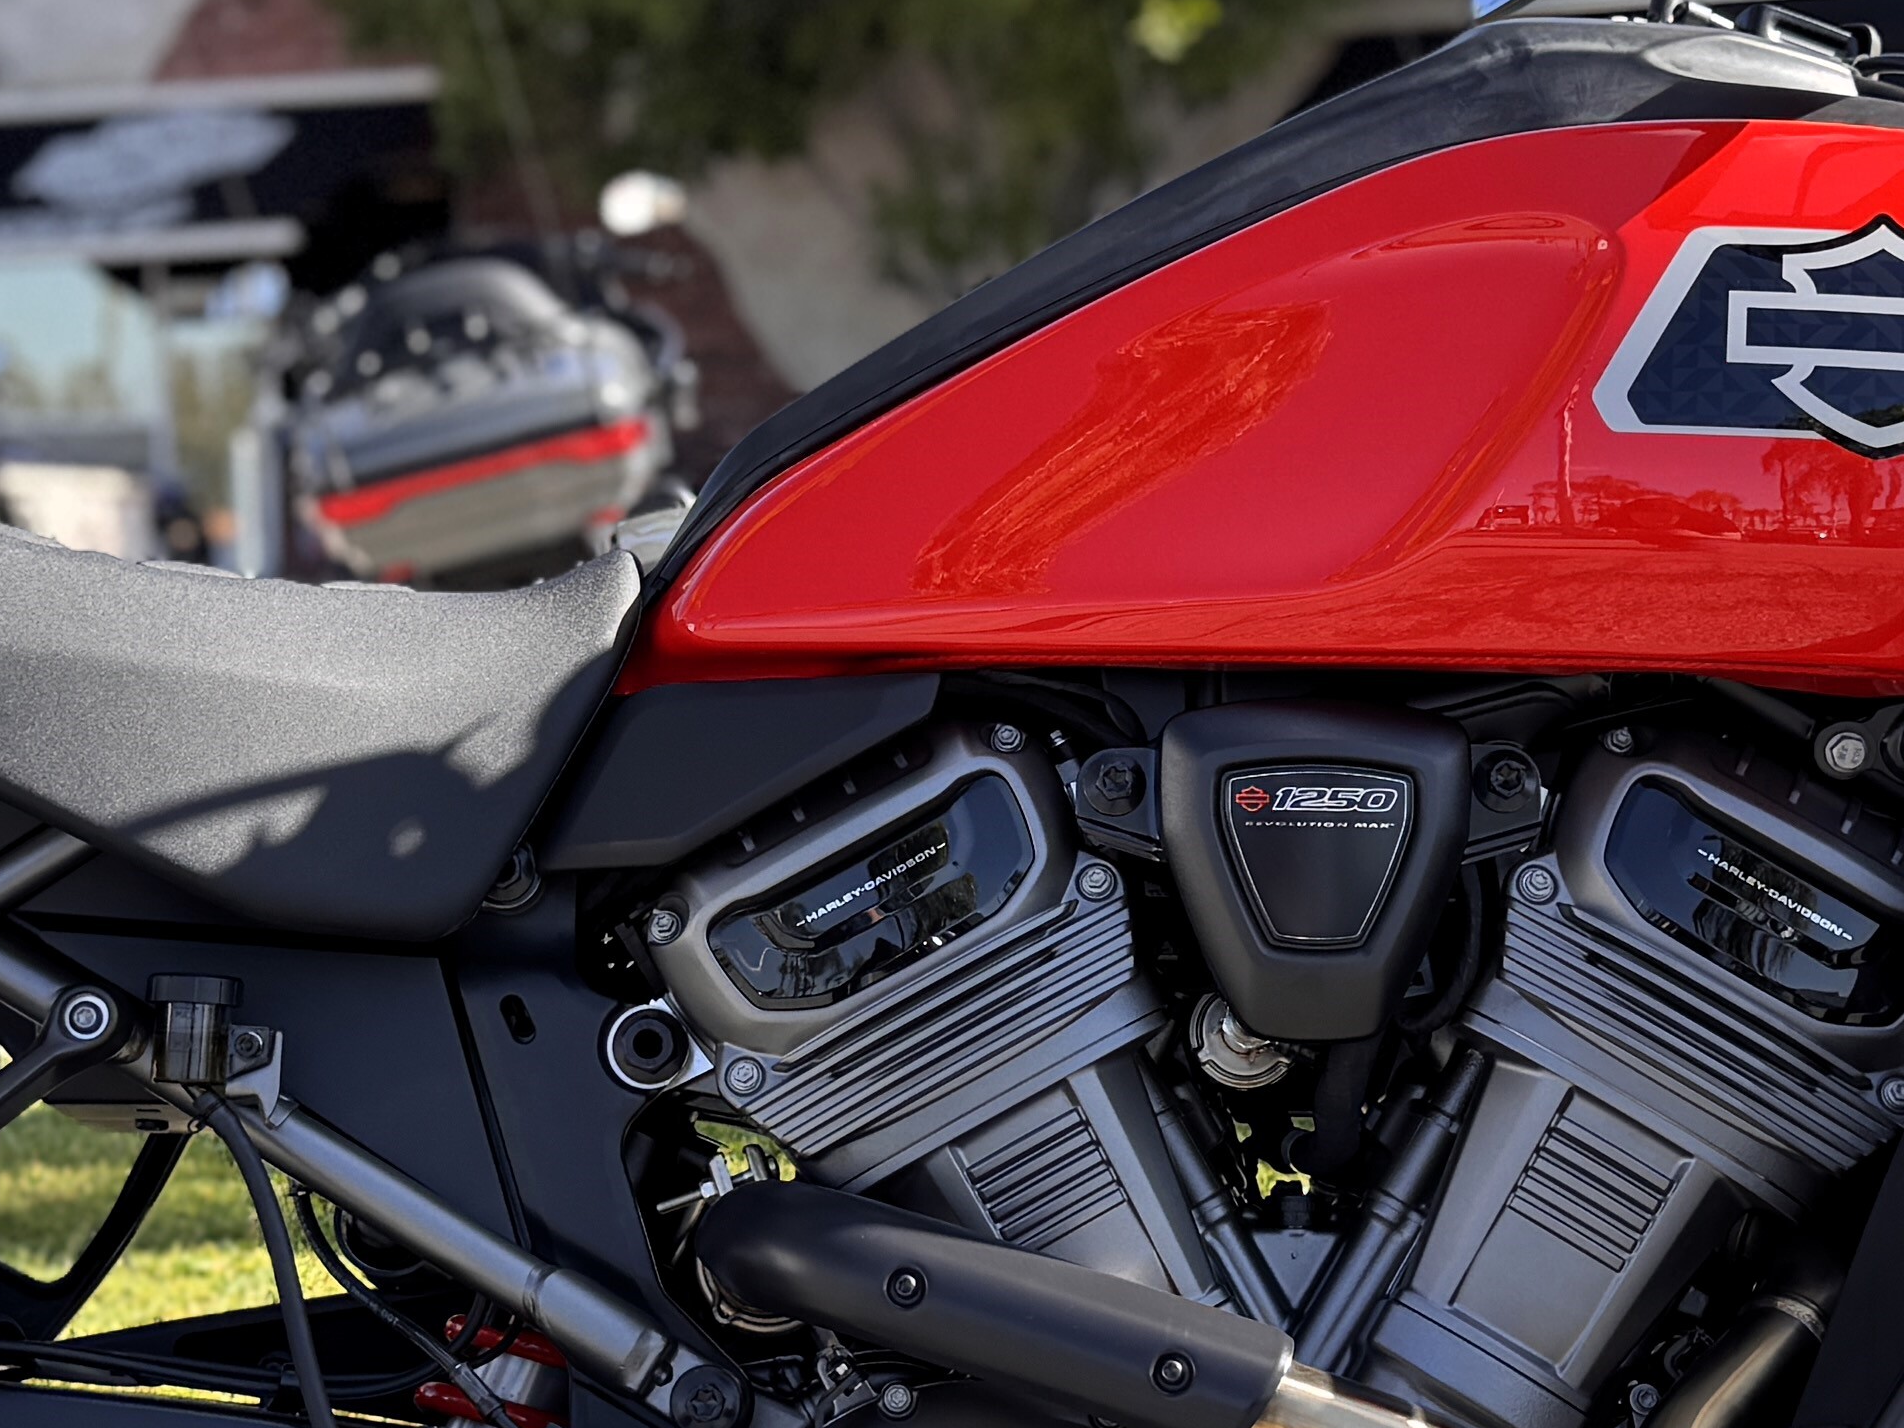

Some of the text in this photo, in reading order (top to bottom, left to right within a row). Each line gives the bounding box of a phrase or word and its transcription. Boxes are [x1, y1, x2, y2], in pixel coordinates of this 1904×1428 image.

[1245, 820, 1348, 829] REVOLUTION
[1272, 786, 1398, 812] 1250
[805, 846, 936, 923] HARLEY-DAVIDSON
[1707, 853, 1843, 936] HARLEY-DAVIDSON
